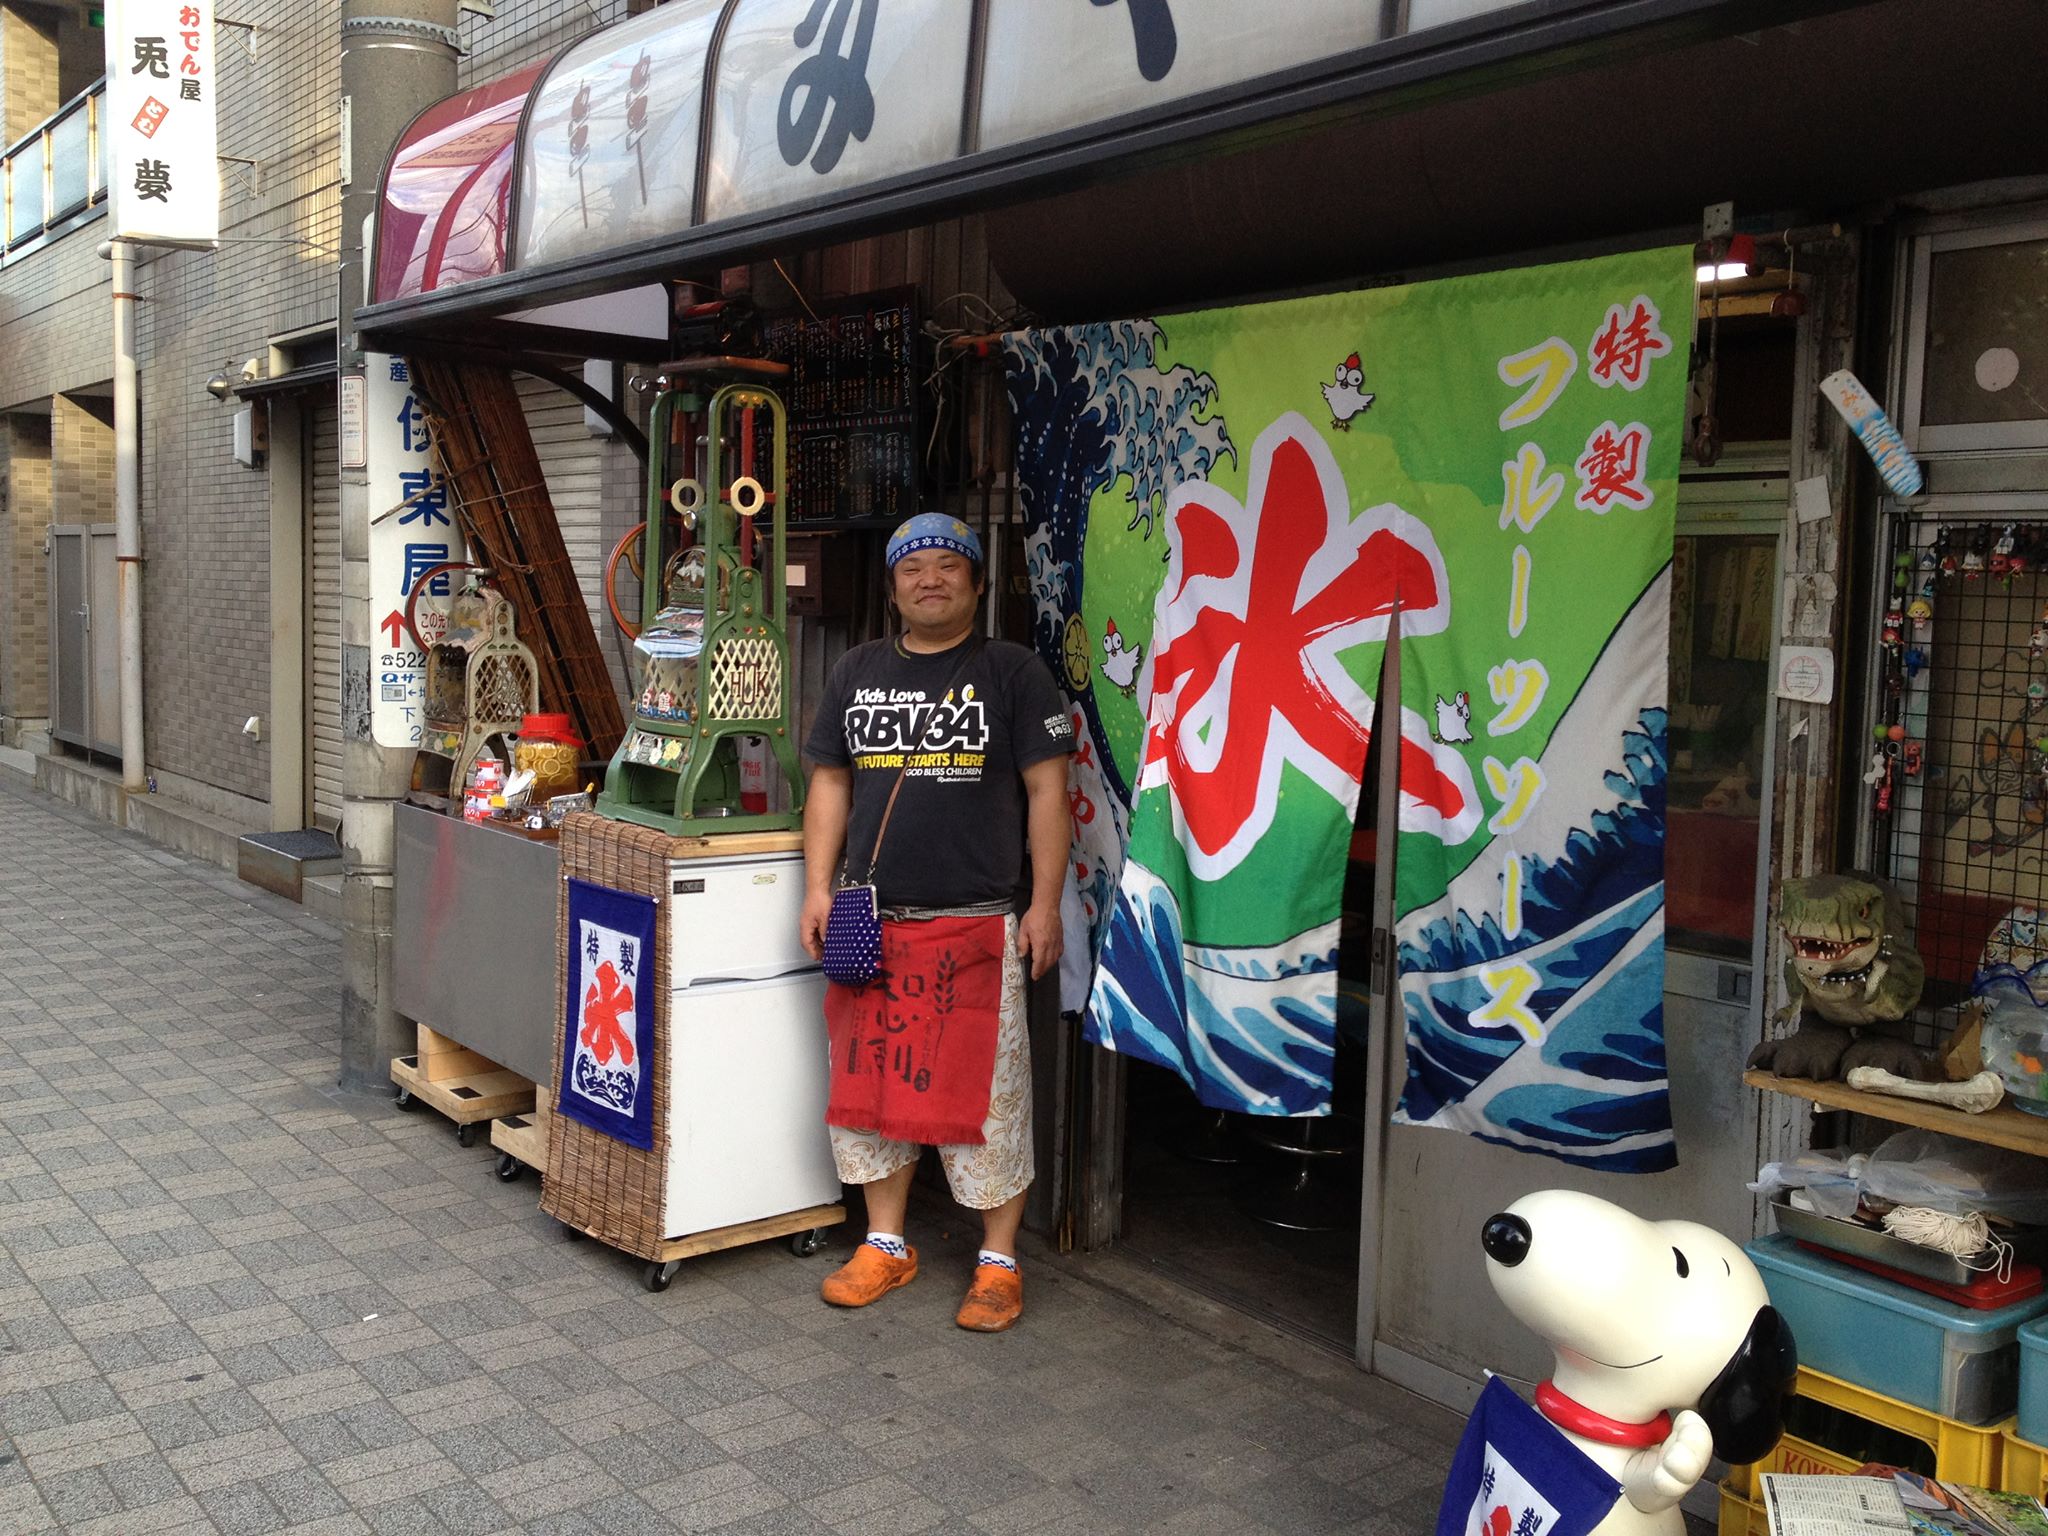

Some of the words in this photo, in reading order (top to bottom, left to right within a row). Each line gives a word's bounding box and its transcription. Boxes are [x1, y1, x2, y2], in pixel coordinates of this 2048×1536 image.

[179, 5, 201, 102] おでん屋
[137, 101, 164, 135] とむ
[1578, 300, 1667, 509] 特製
[1138, 435, 1465, 857] 氷
[1474, 342, 1574, 1044] フルーツソース
[854, 688, 887, 704] Kids
[888, 688, 926, 703] Love
[863, 754, 904, 769] FUTURE
[907, 753, 950, 767] STARTS
[953, 752, 986, 767] HERE
[905, 767, 923, 777] GOD
[924, 767, 945, 776] BLESS
[946, 767, 982, 776] CHILDREN
[580, 960, 634, 1067] 氷
